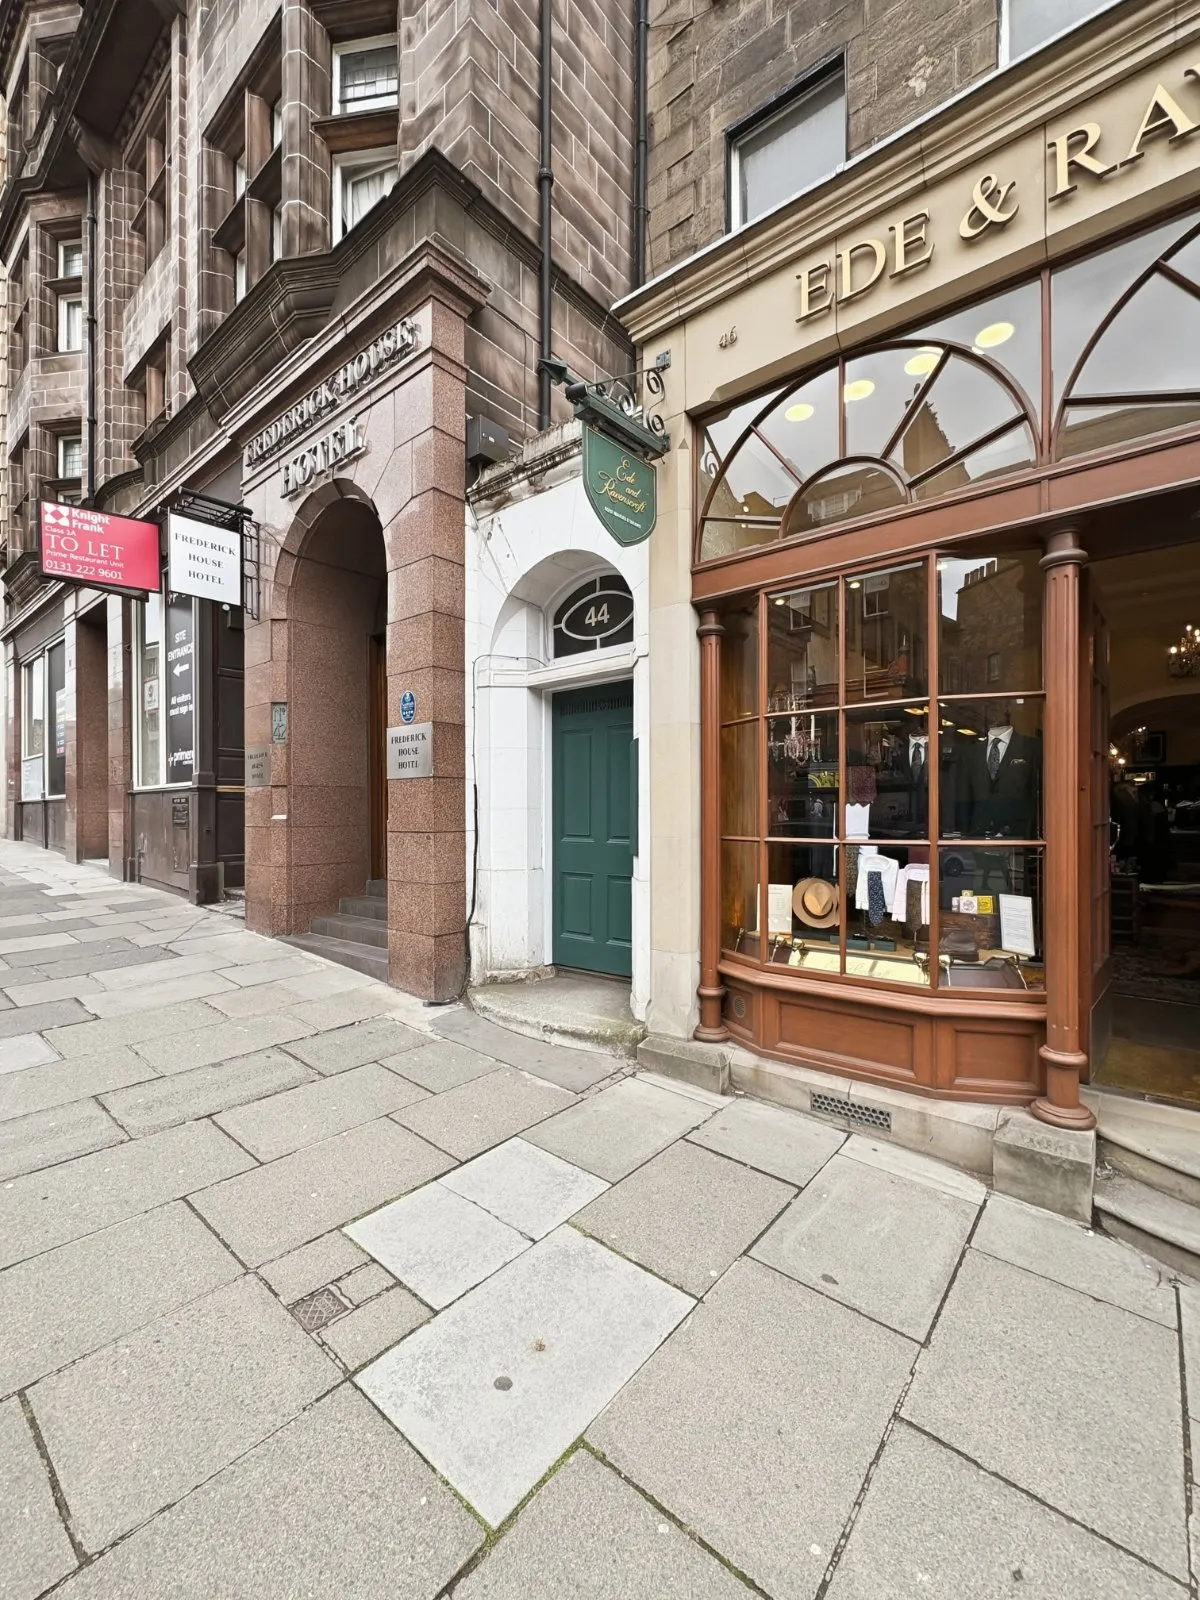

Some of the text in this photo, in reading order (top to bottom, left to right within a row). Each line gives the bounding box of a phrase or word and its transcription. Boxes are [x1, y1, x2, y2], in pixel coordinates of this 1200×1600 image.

[795, 63, 1200, 324] EDE & RA
[718, 324, 738, 348] 46
[243, 317, 419, 468] FREDERICK HOUSE
[280, 416, 366, 498] HOTEL
[616, 454, 636, 484] Ede
[625, 485, 642, 499] and
[72, 508, 111, 525] Knight
[45, 525, 65, 535] Class
[72, 519, 105, 534] Frank
[45, 533, 125, 561] TO LET
[174, 532, 236, 557] FREDERICK
[45, 549, 68, 559] Prime
[69, 552, 108, 566] Restaurant
[188, 553, 224, 569] HOUSE
[45, 559, 73, 572] 0131
[75, 564, 96, 576] 222
[98, 568, 123, 580] 9601
[188, 570, 225, 586] HOTEL
[584, 602, 610, 627] 44
[174, 629, 187, 644] SITE
[391, 732, 427, 745] FREDERICK
[398, 746, 420, 757] HOUSE
[398, 760, 420, 770] HOTEL
